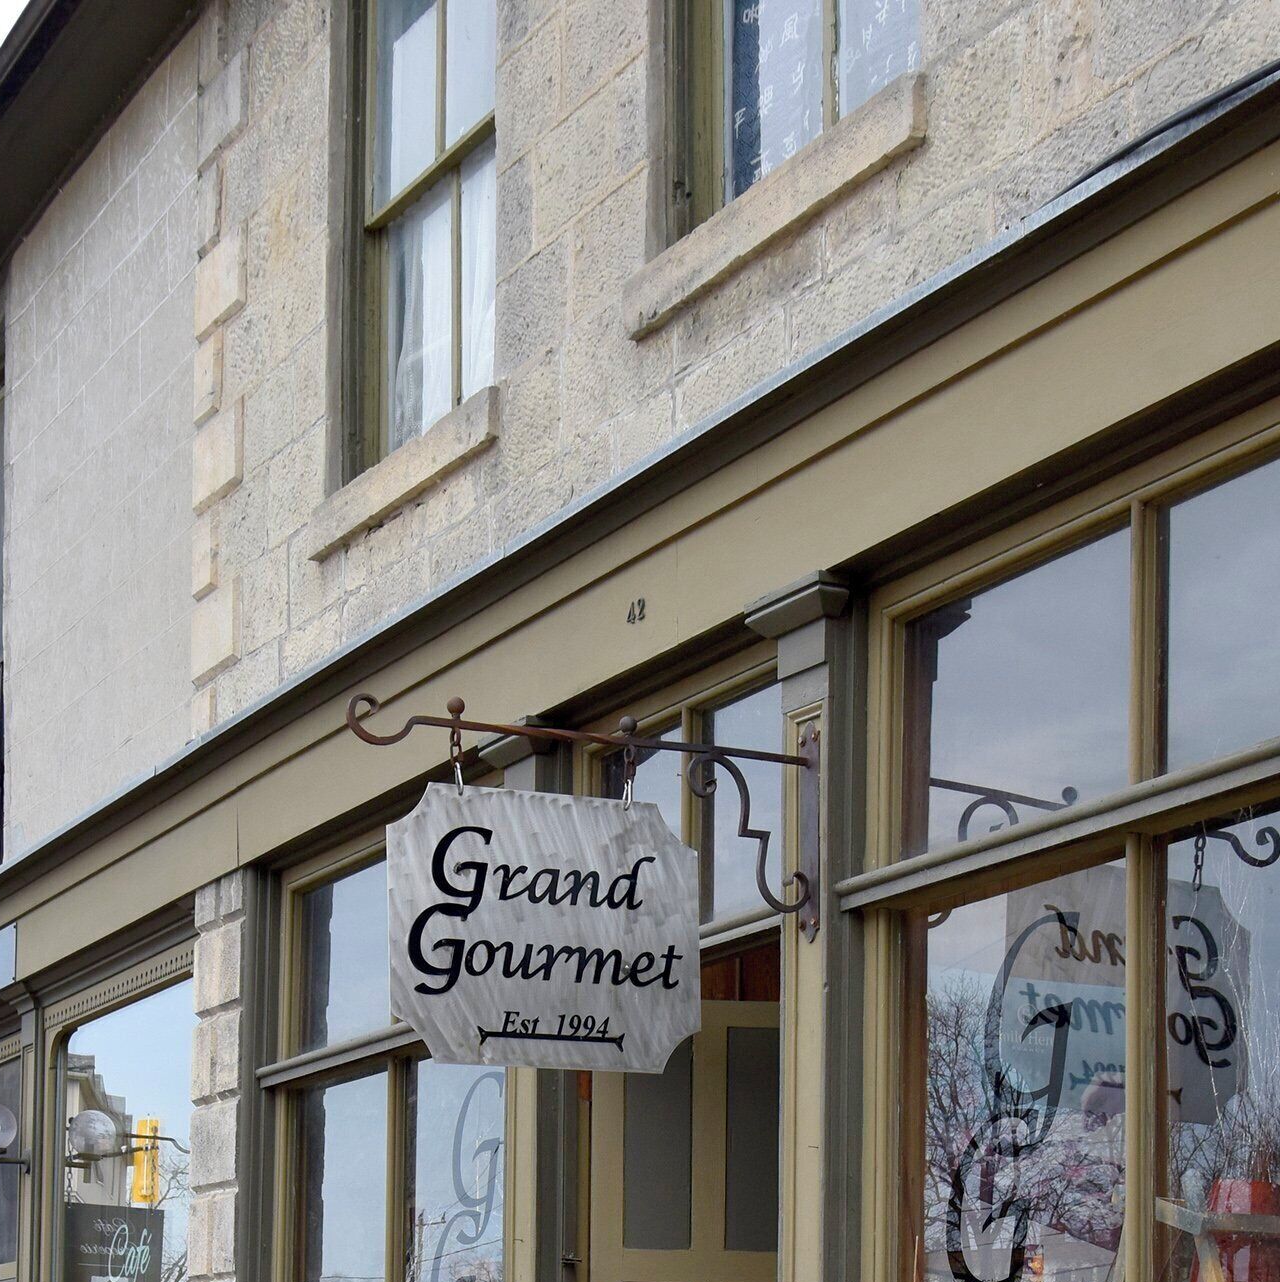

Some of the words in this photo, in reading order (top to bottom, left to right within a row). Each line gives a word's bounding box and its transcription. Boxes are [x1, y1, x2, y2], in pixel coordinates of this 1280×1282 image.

[626, 597, 646, 624] 42
[431, 825, 656, 922] Grand
[407, 902, 683, 995] Gourmet
[557, 1013, 610, 1039] 1994
